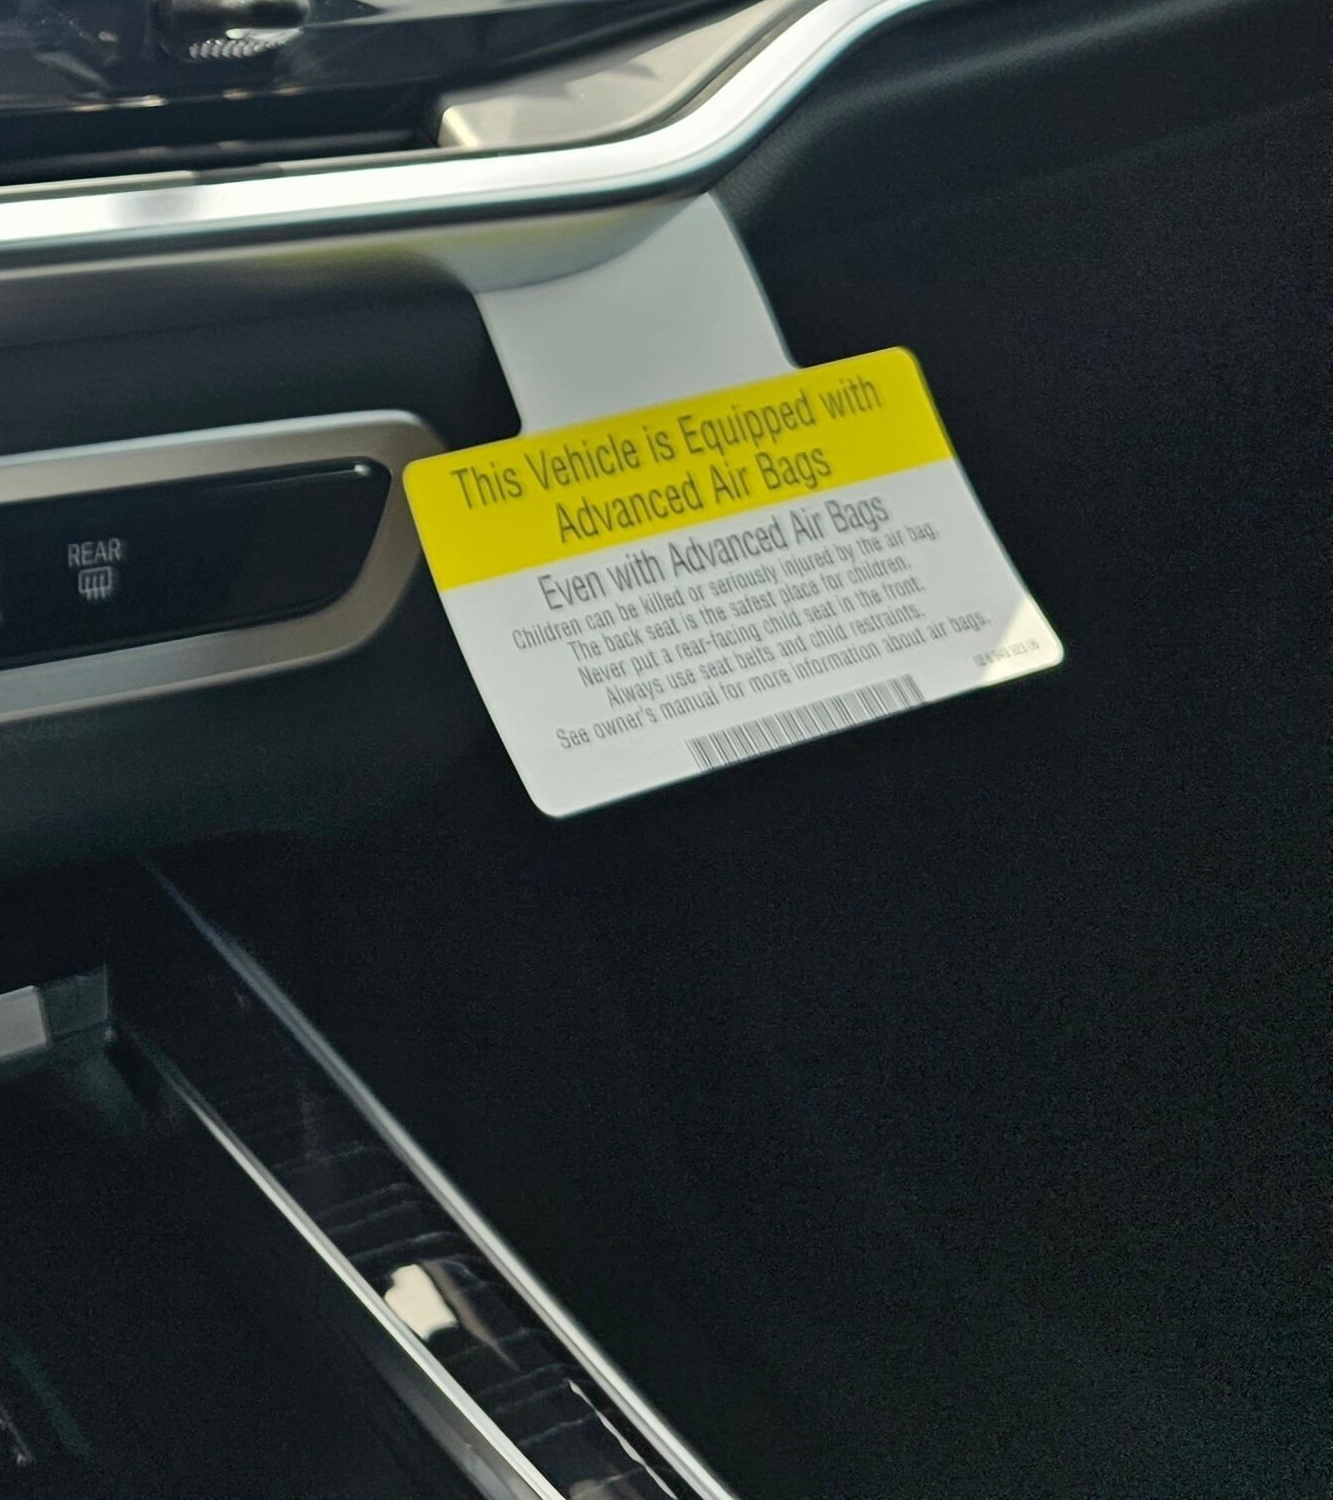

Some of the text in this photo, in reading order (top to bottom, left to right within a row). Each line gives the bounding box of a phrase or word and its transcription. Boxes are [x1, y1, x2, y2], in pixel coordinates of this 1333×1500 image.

[451, 375, 881, 508] This Vehicle is Equipped with
[557, 448, 831, 543] Advanced Air Bags
[68, 538, 123, 567] REAR
[513, 523, 939, 649] Children can be killed or seriously injured by the air bag.
[539, 497, 888, 609] Even with Advanced Air Bags
[568, 556, 910, 662] The back seat is the safest place for children.
[579, 660, 625, 687] Never
[631, 650, 658, 676] put
[662, 648, 672, 664] a
[676, 624, 761, 660] rear-facing
[764, 608, 801, 634] child
[805, 601, 836, 623] seat
[836, 595, 854, 613] in
[856, 589, 882, 608] the
[607, 604, 924, 708] Always use seat belts and child restraints.
[557, 612, 990, 749] See owner's manual for more information about air bags.
